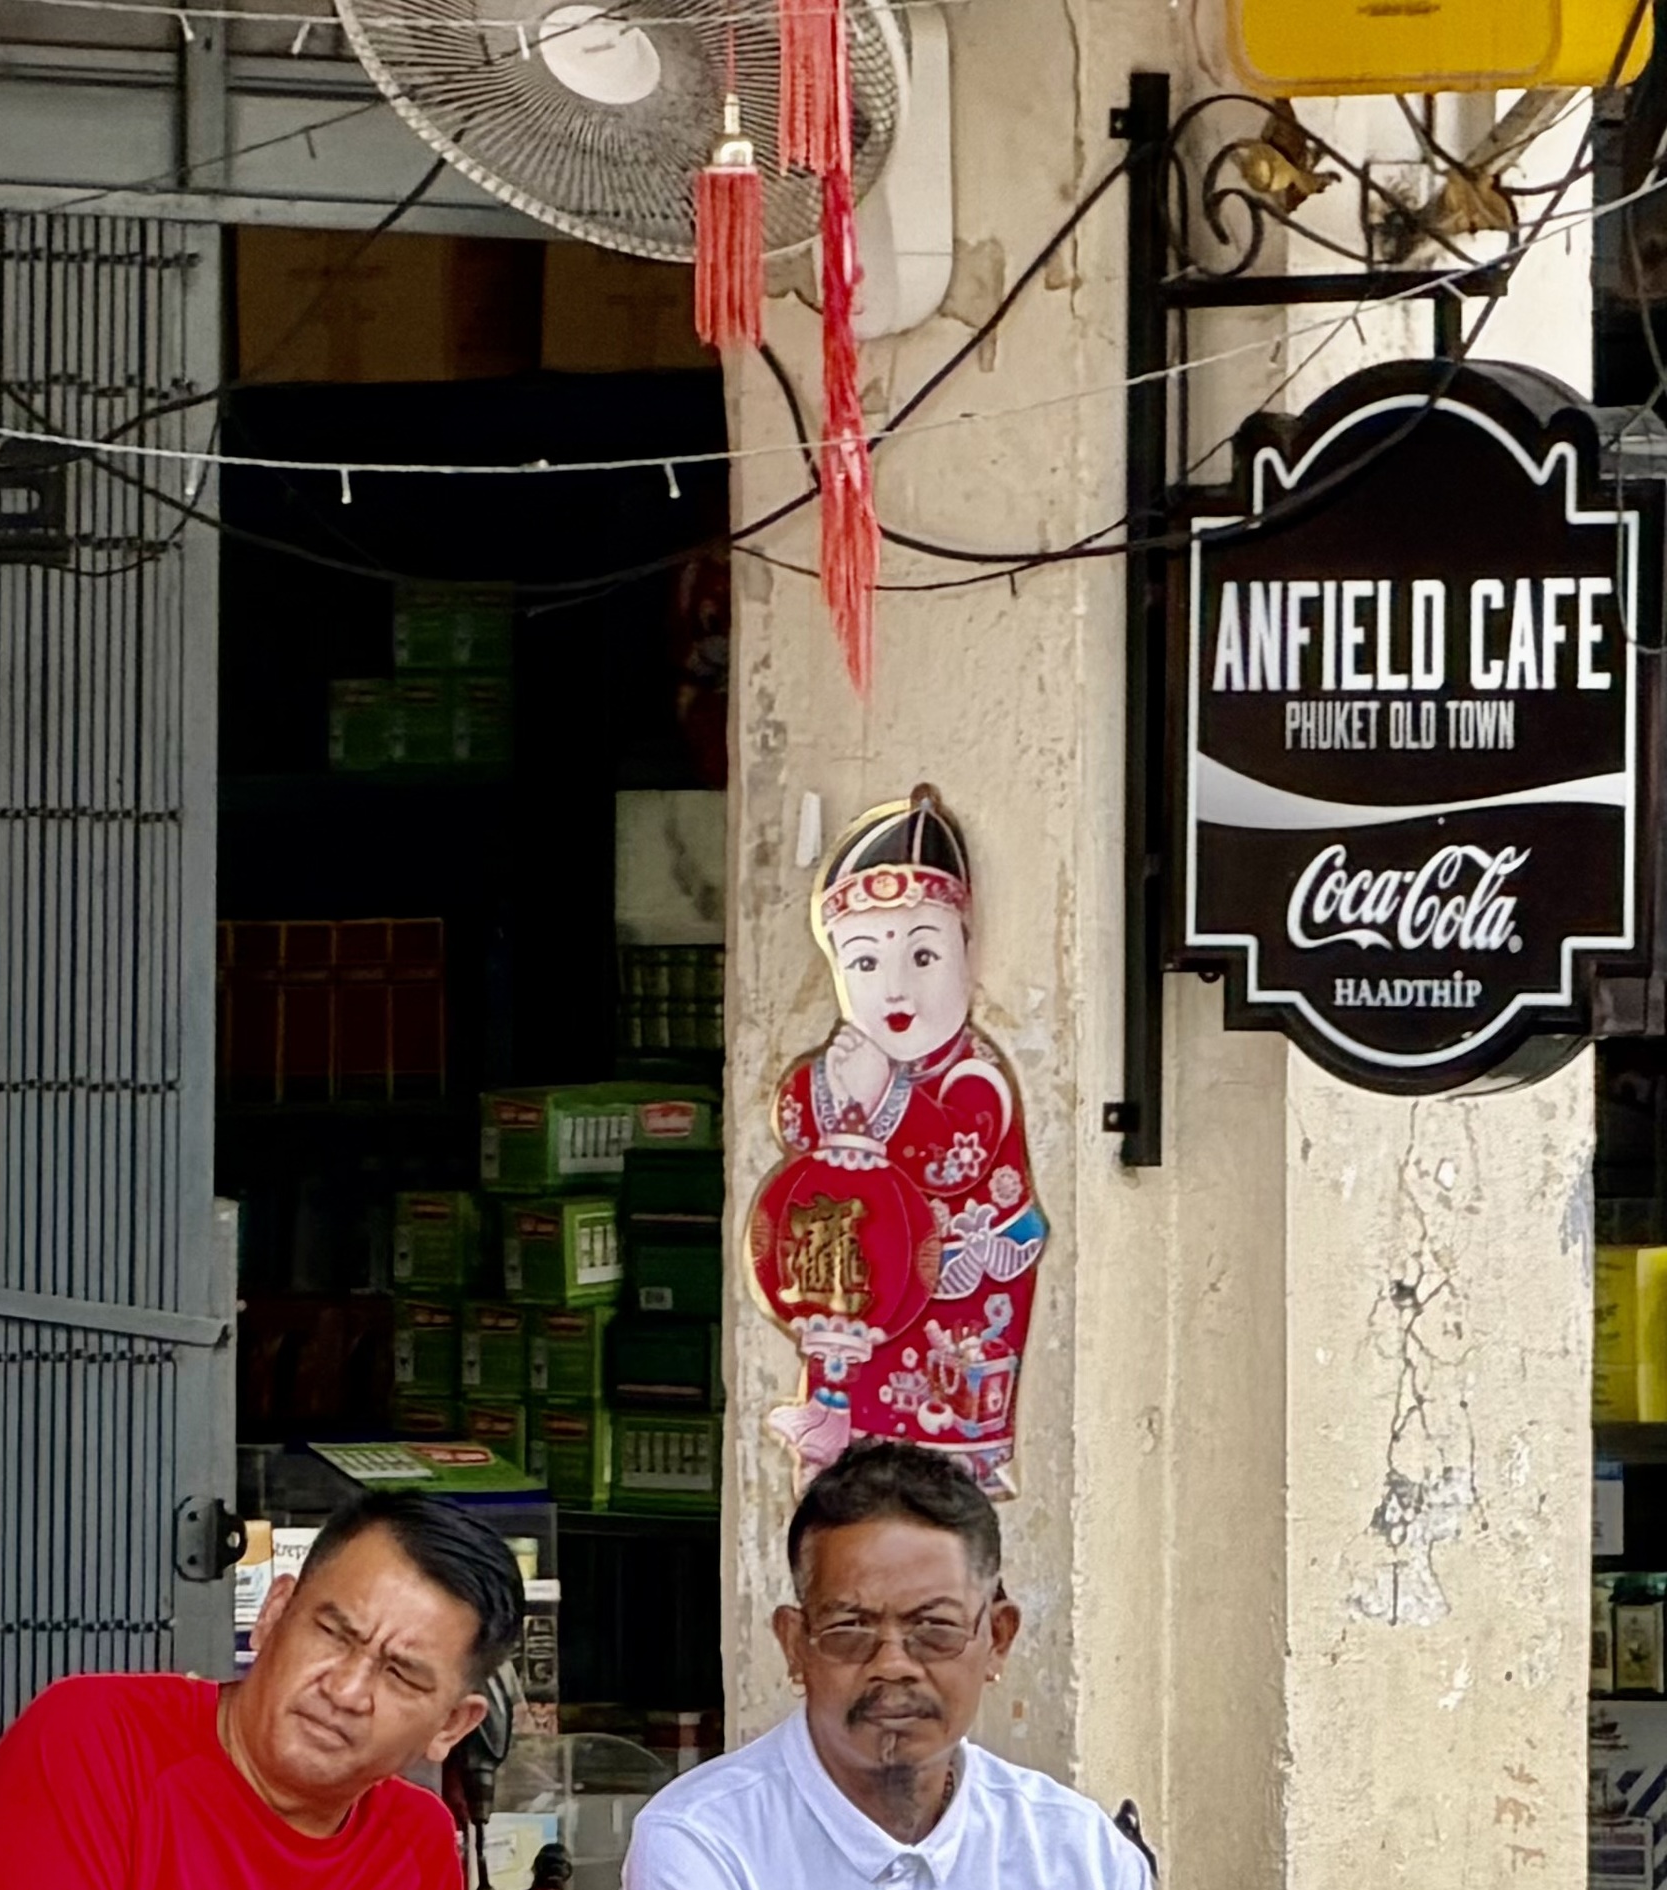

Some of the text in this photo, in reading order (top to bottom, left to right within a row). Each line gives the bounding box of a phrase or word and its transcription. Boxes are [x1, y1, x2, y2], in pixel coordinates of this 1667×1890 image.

[1213, 577, 1613, 692] ANFIELD CAFE
[1285, 701, 1515, 750] PHUKET OLD TOWN
[1286, 843, 1532, 952] Coca-Cola
